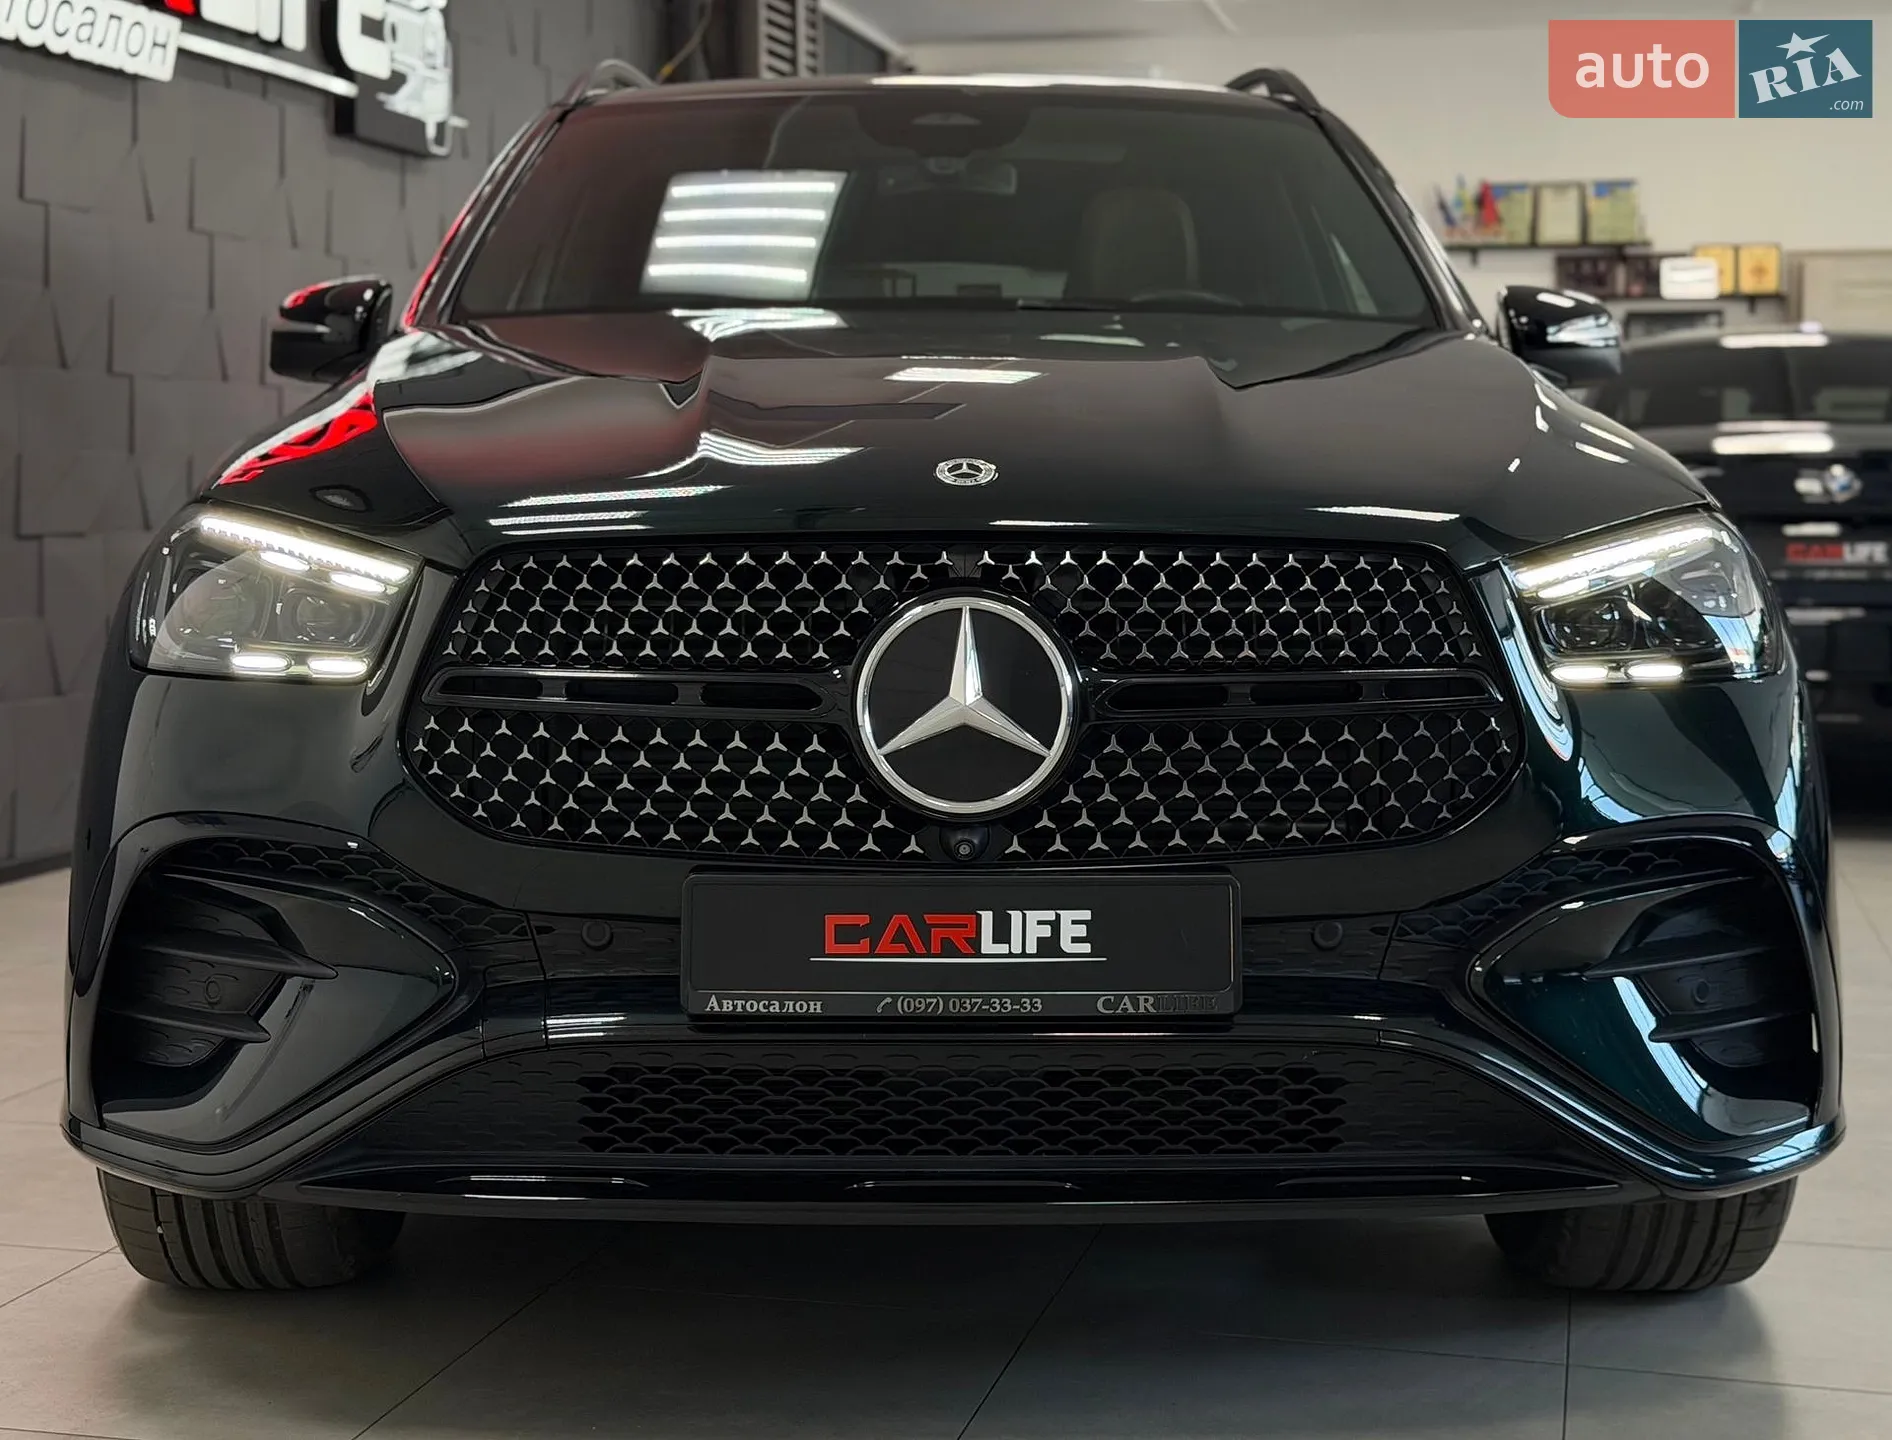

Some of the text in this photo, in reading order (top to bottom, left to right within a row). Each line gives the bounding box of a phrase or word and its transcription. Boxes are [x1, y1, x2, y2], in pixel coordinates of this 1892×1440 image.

[824, 910, 1092, 955] CARLIFE
[704, 994, 823, 1013] Автосалон
[897, 996, 1043, 1015] (097) 037-33-33
